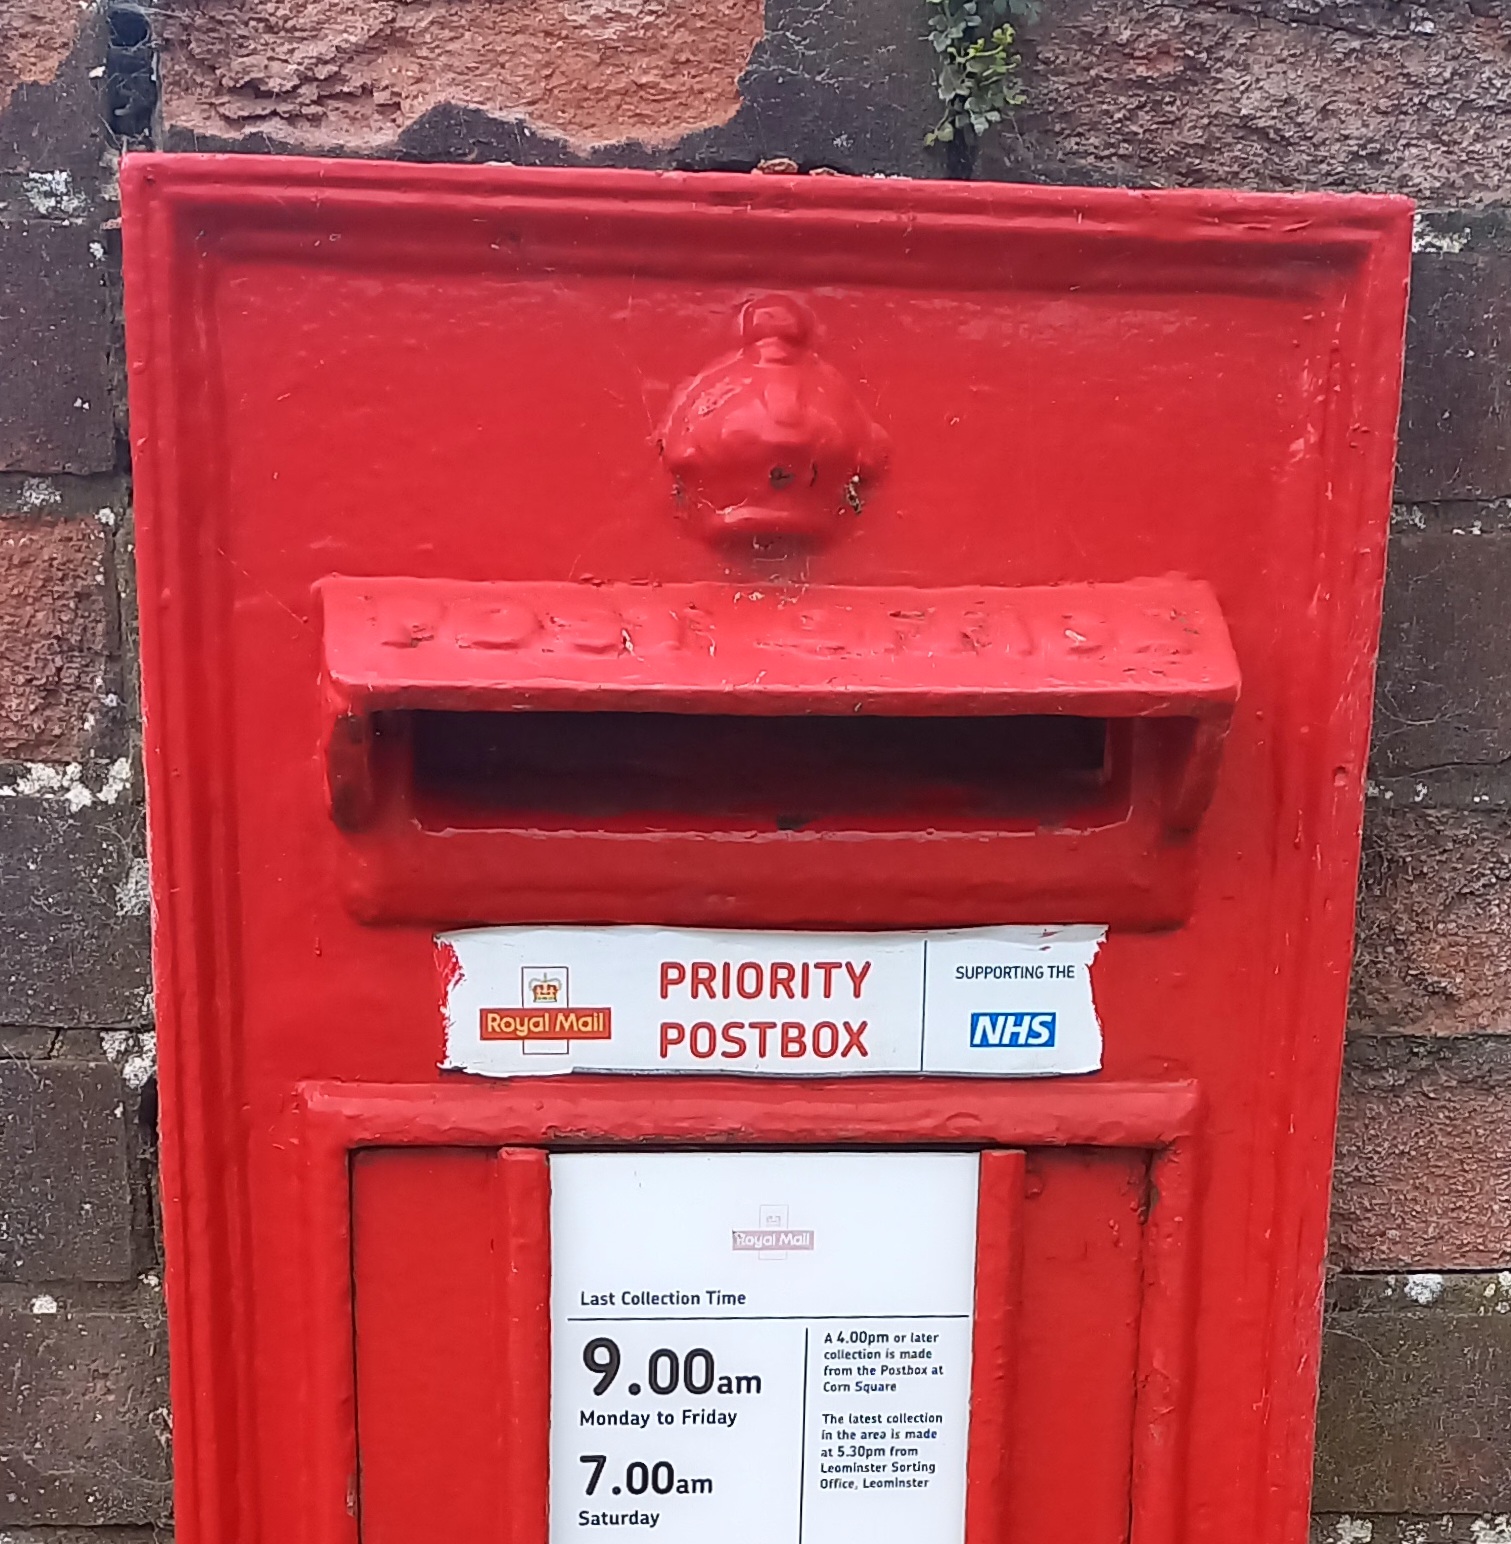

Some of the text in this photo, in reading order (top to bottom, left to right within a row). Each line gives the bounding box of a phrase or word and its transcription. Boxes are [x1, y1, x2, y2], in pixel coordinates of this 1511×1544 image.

[660, 960, 872, 1001] PRIORITY
[955, 964, 1075, 981] SUPPORTING THE
[486, 1012, 605, 1037] Royal Mail
[972, 1014, 1054, 1045] NHS
[660, 1020, 869, 1060] POSTBOX
[734, 1231, 809, 1248] Royal Mail
[580, 1289, 747, 1307] Last Collection Time
[824, 1330, 940, 1347] A 4.00pm or later
[823, 1347, 933, 1361] collection is made
[582, 1336, 762, 1397] 9.00am
[823, 1364, 944, 1377] from the Postbox at
[823, 1380, 897, 1395] Corn Square
[579, 1409, 738, 1429] Monday to Friday
[821, 1412, 943, 1425] The latest collection
[821, 1428, 938, 1441] in the area is made
[820, 1444, 919, 1460] at 5.30pm from
[579, 1454, 713, 1497] 7.00am
[820, 1461, 936, 1475] Leominster Sorting
[819, 1476, 930, 1491] Office, Leominster
[578, 1510, 660, 1529] Saturday
